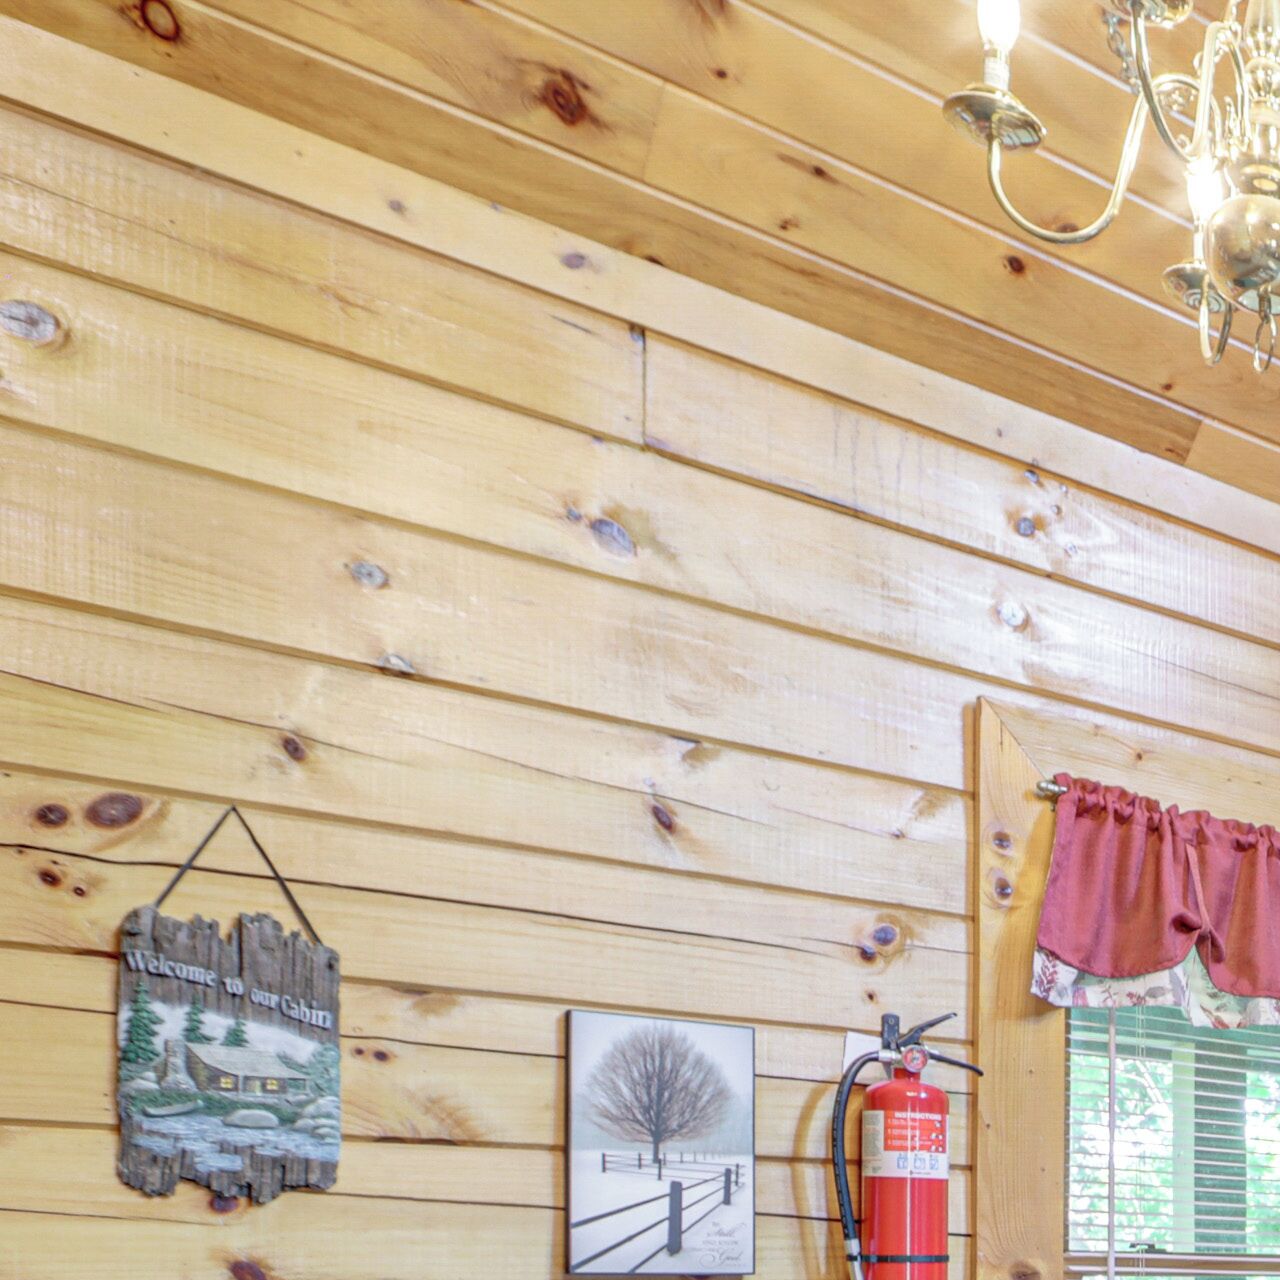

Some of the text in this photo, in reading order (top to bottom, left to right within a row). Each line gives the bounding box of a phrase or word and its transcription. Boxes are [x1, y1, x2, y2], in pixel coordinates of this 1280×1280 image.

[125, 950, 332, 1031] Welcome to our Cabin
